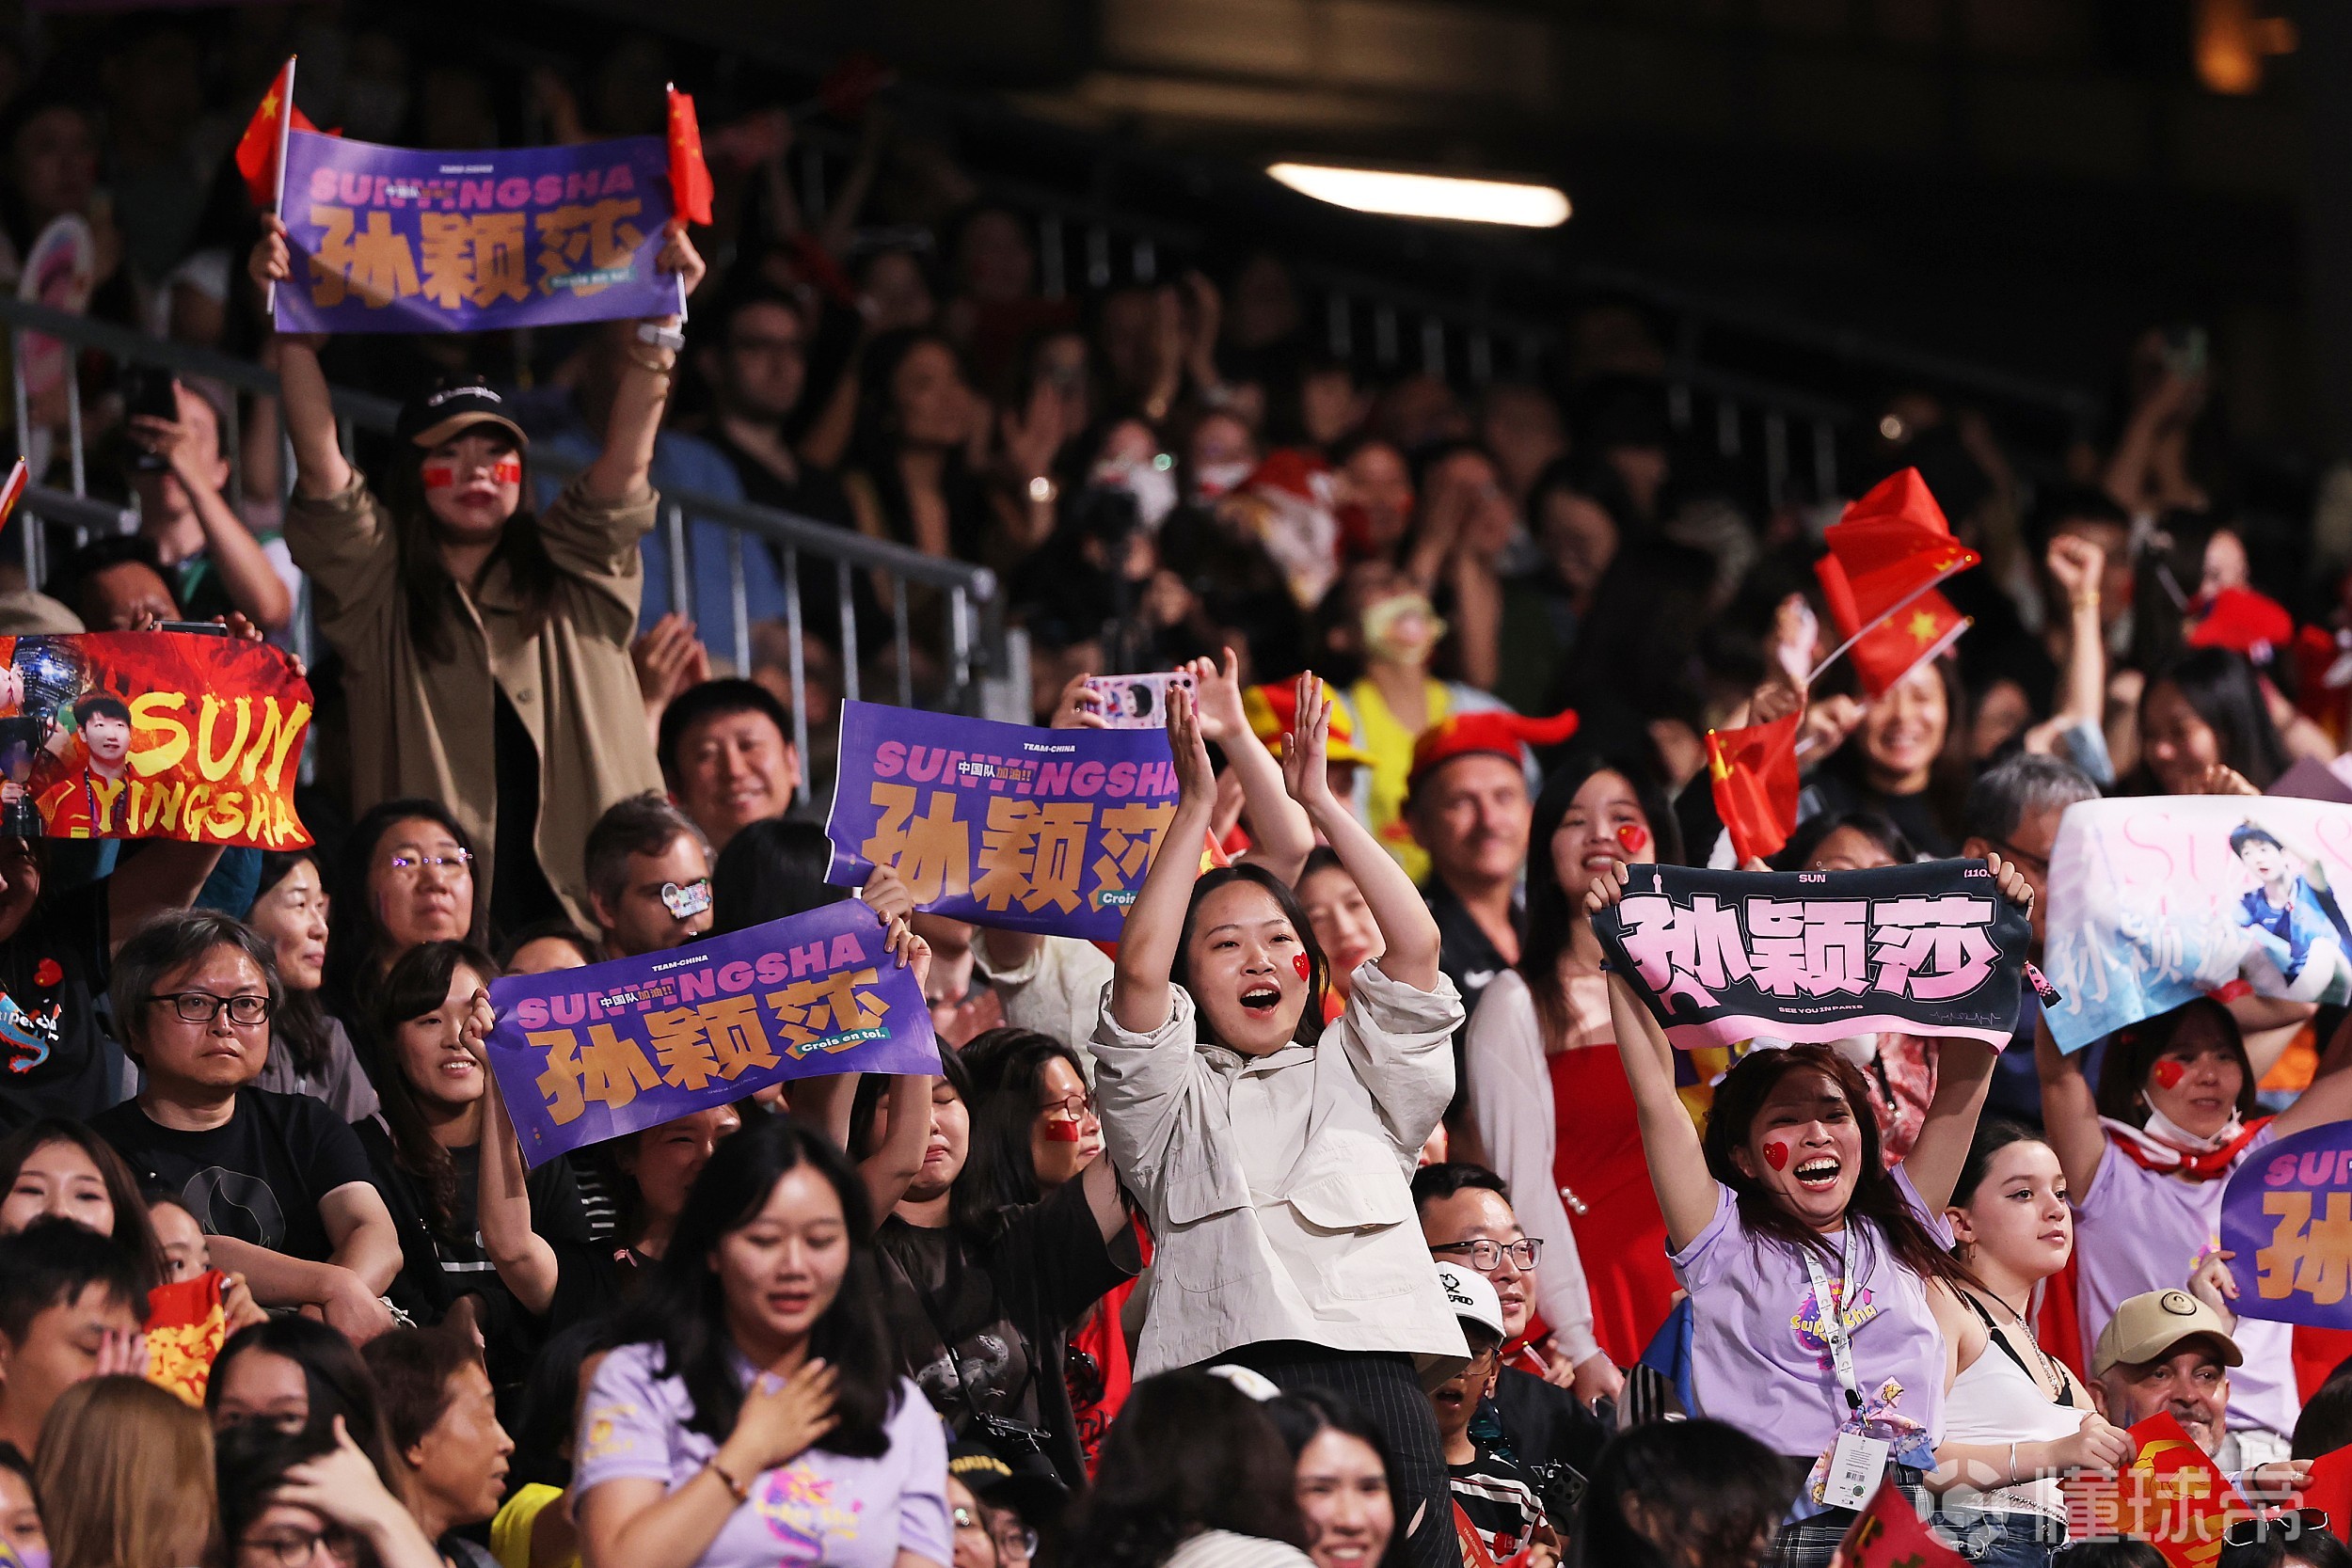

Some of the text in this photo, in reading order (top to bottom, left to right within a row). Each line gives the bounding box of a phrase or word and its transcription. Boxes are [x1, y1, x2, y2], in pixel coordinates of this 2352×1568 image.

[309, 198, 644, 309] 孙颖莎
[126, 691, 313, 792] SUN
[90, 780, 307, 847] YINGSHA
[1798, 874, 1826, 883] SUN
[651, 954, 709, 973] TEAM-CHINA
[1618, 896, 1999, 999] 孙颖莎
[524, 966, 891, 1127] 孙颖莎
[801, 1028, 886, 1053] Crois en toi.
